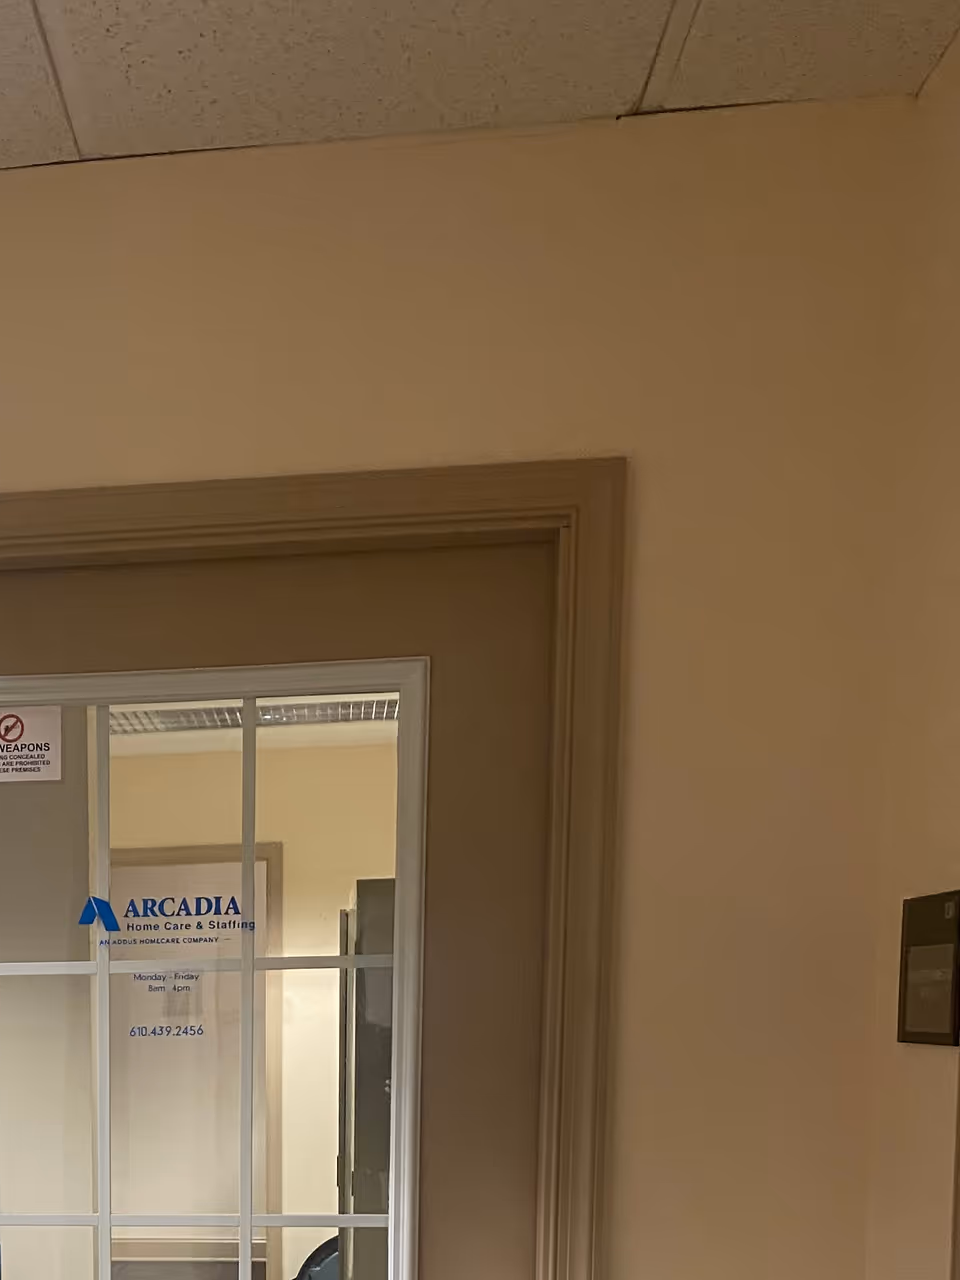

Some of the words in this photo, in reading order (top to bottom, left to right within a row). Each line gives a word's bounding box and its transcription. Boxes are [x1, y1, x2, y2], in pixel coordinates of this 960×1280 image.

[122, 896, 242, 918] ARCADIA
[126, 921, 160, 932] Home
[164, 921, 192, 931] Care
[195, 921, 204, 930] &
[208, 919, 256, 931] Staffing
[99, 938, 110, 946] AN
[139, 937, 181, 945] HOMECARE
[182, 936, 219, 944] COMPANY
[133, 973, 167, 982] Monday
[174, 972, 200, 982] Friday
[129, 1024, 204, 1037] 610.439.2456
